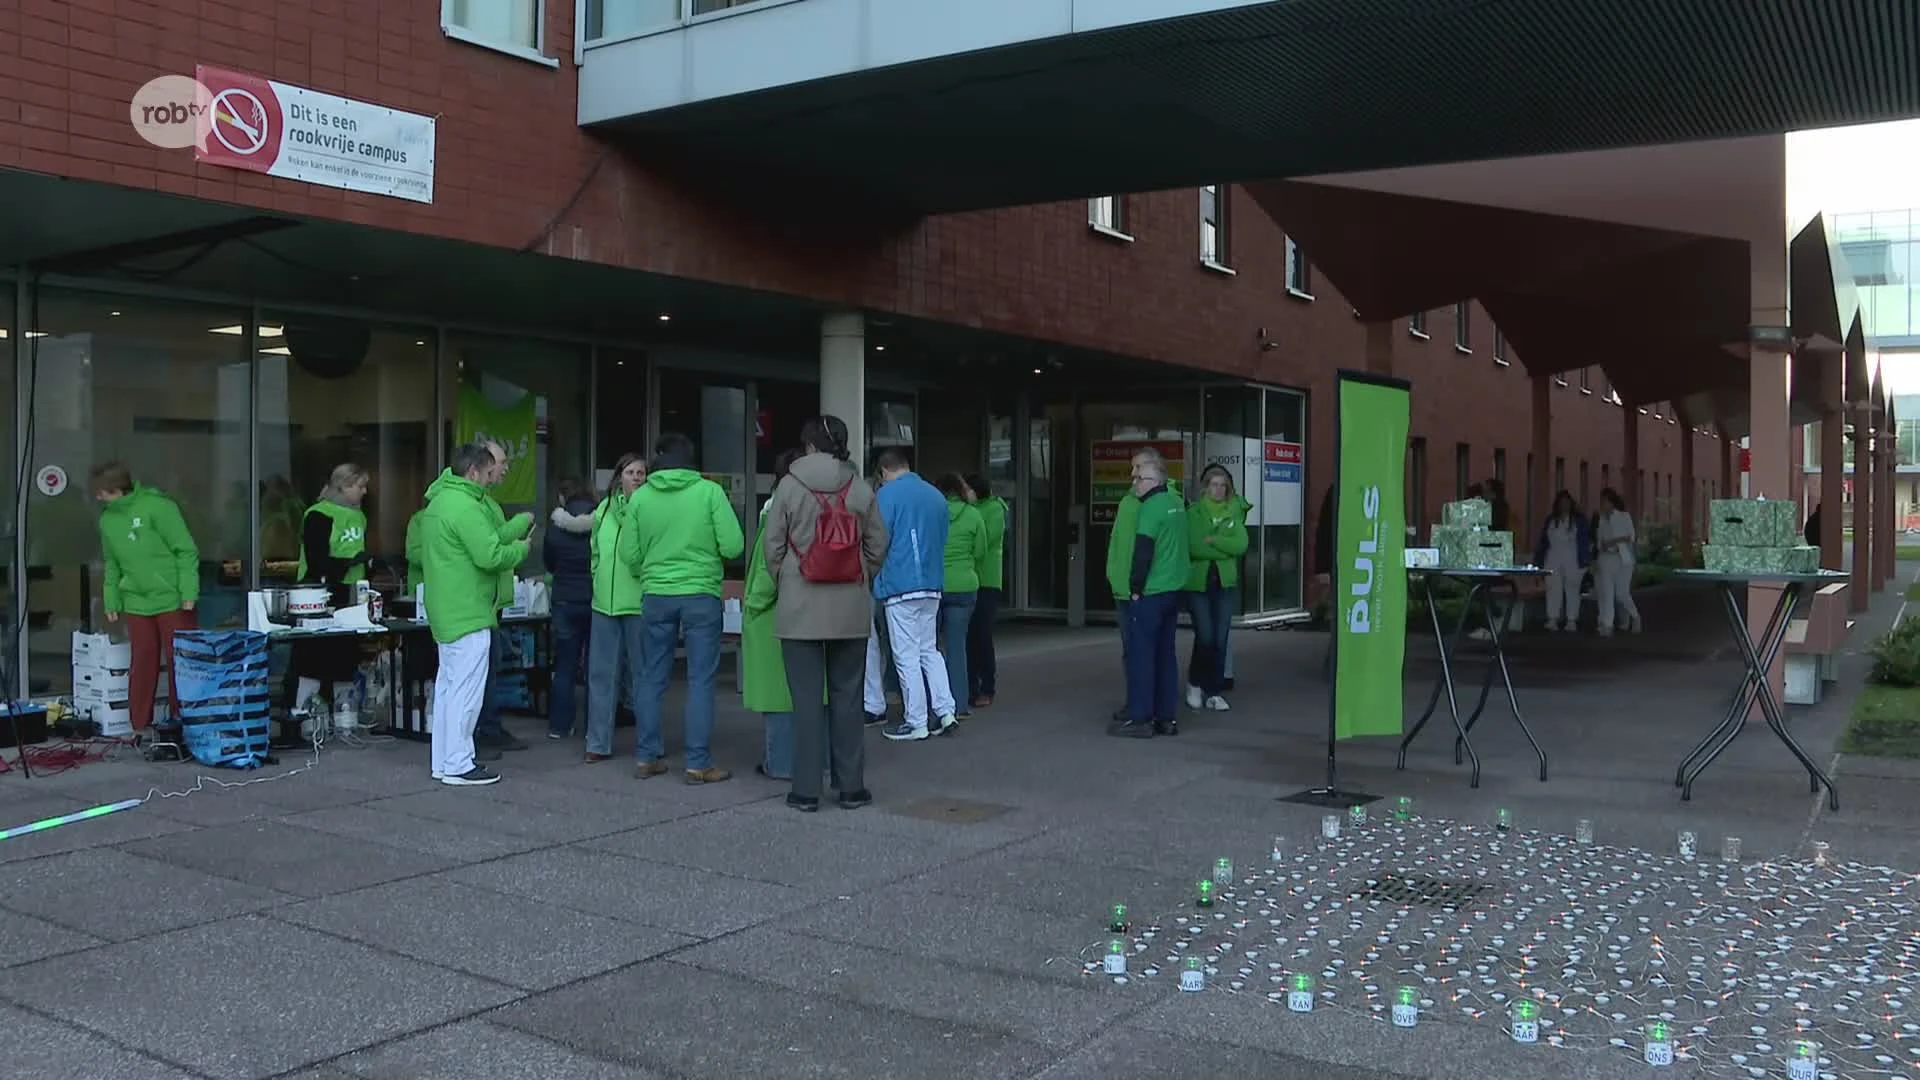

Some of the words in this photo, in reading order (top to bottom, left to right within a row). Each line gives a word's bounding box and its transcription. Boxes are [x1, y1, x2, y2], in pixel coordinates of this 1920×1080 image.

[291, 103, 313, 122] Dit
[317, 108, 329, 126] is
[332, 115, 357, 132] een
[289, 128, 355, 154] rookvrije
[358, 141, 408, 163] campus
[1349, 484, 1381, 634] PULS
[1292, 999, 1310, 1009] KAN
[1649, 1051, 1668, 1063] ONS
